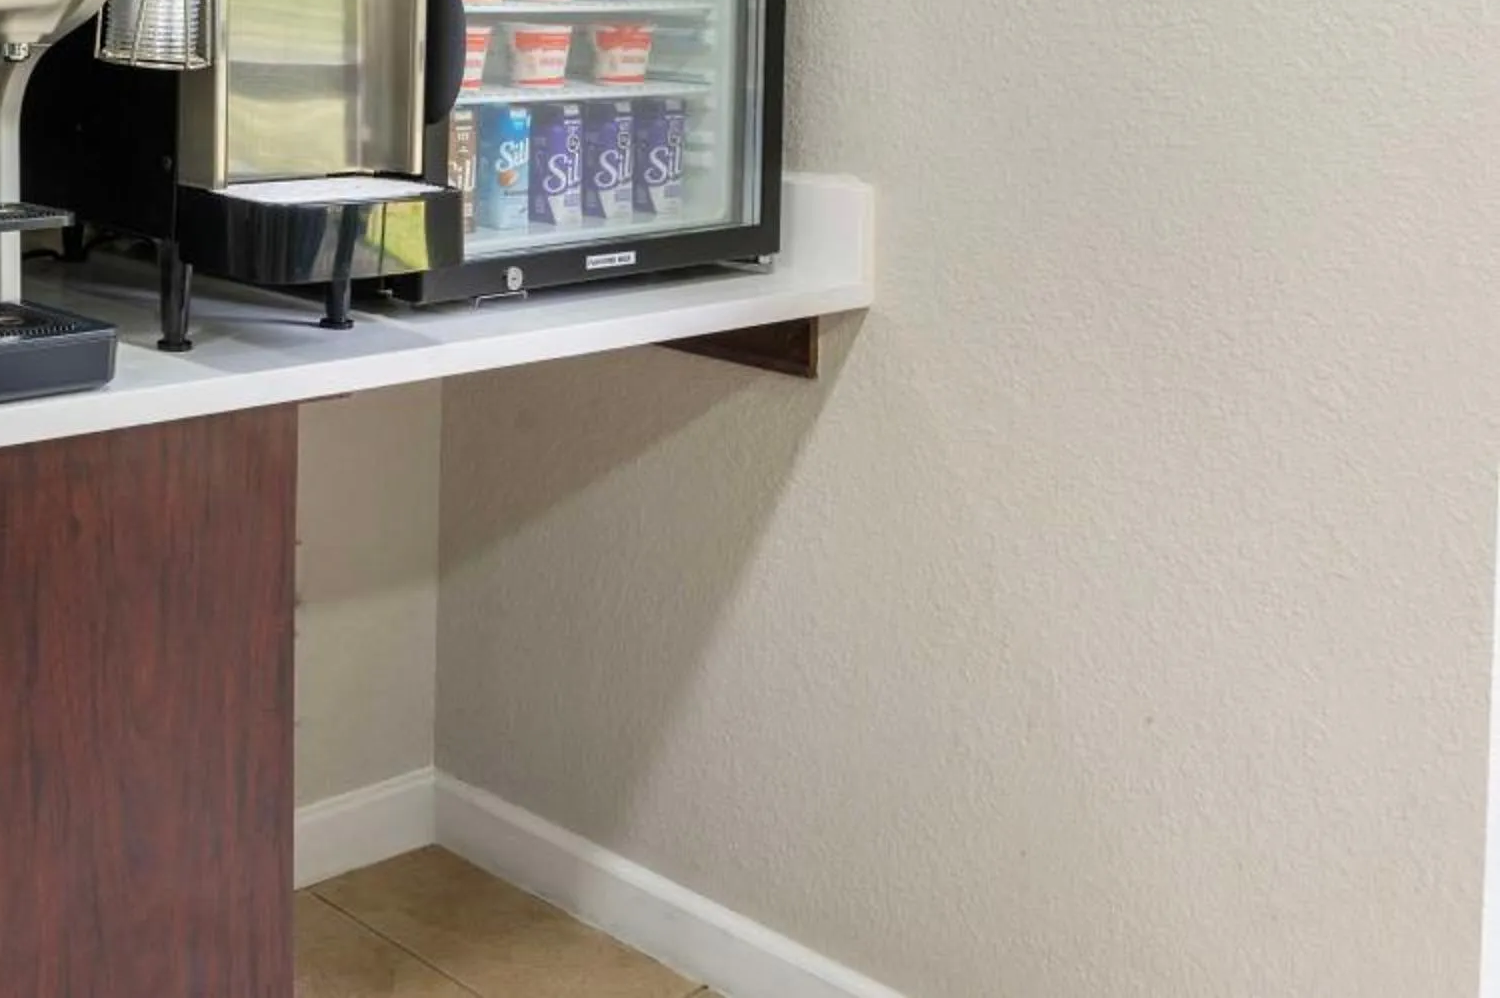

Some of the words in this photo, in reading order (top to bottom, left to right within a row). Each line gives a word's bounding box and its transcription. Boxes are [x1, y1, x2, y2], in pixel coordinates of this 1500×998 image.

[543, 148, 581, 193] Sil
[594, 147, 632, 188] Sil
[645, 143, 683, 184] Sil
